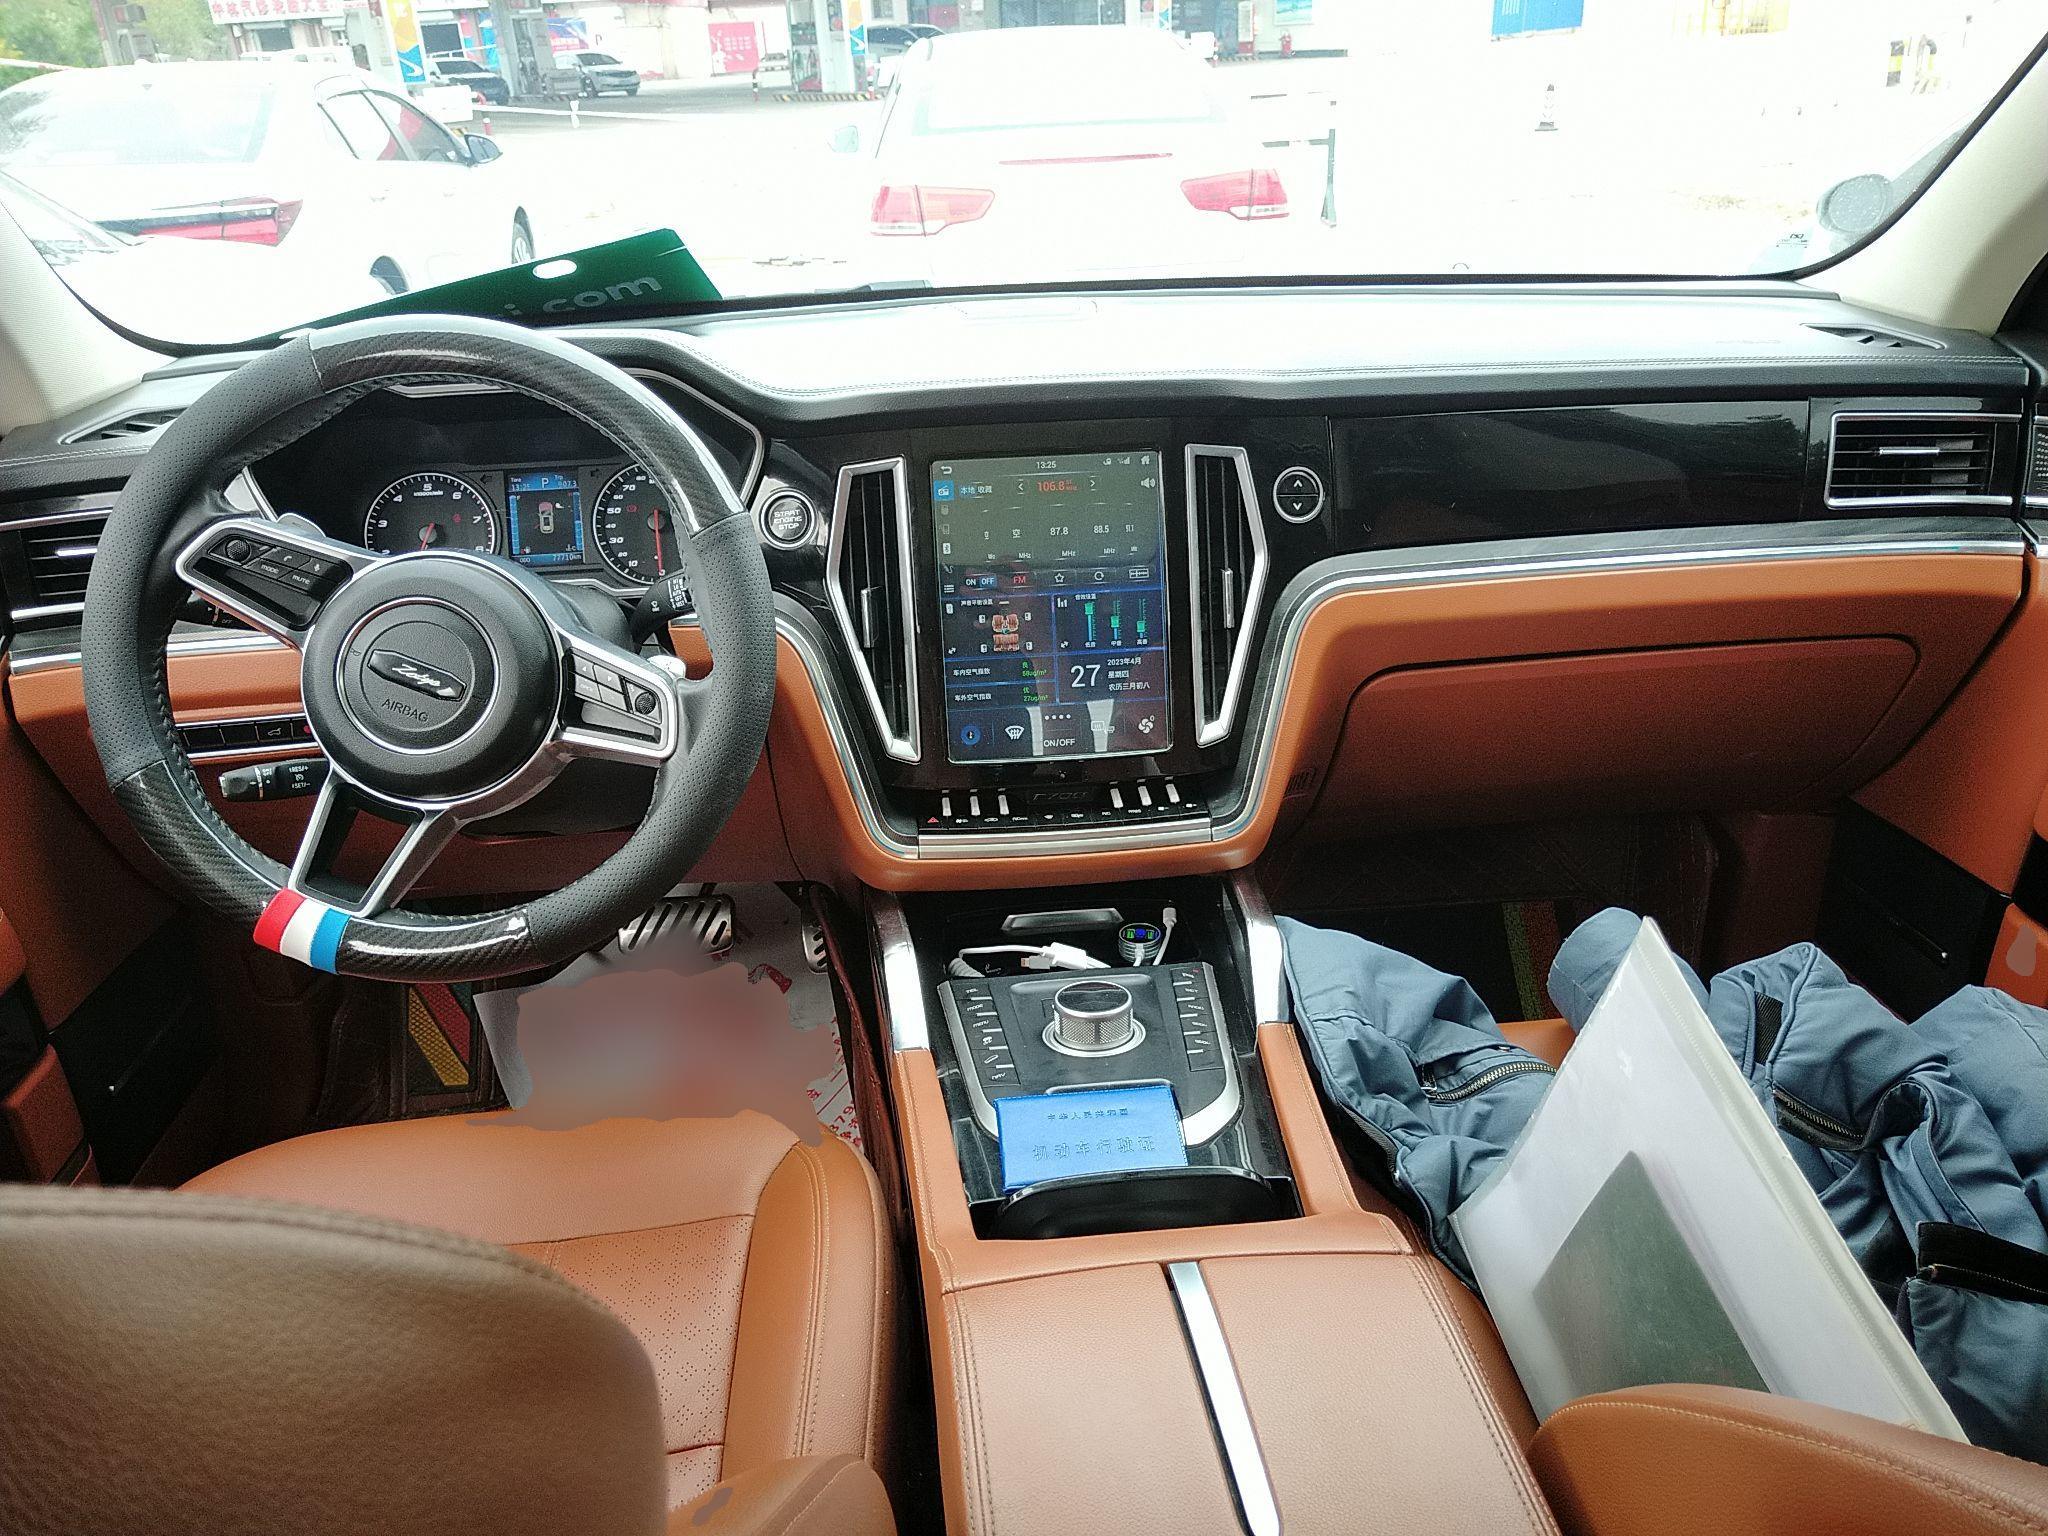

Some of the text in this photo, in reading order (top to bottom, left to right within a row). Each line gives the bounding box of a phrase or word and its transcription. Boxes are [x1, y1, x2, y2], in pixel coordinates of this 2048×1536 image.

[1036, 461, 1057, 469] 13:25
[423, 483, 432, 491] 5
[541, 477, 549, 488] P
[1037, 480, 1065, 491] 106.8
[774, 509, 801, 518] START
[378, 520, 388, 528] 3
[472, 516, 482, 524] 7
[778, 522, 800, 530] STOP
[1050, 526, 1069, 536] 87.8
[609, 536, 624, 544] 30
[1061, 550, 1077, 558] MHz
[965, 577, 995, 586] ON OFF
[1013, 576, 1027, 584] FM
[1107, 656, 1142, 666] 2023年4月
[1070, 664, 1101, 688] 27
[1107, 670, 1130, 679] 星期四
[381, 698, 429, 723] AIRBAG
[1043, 737, 1076, 748] ON/OFF
[1032, 1136, 1155, 1162] 机动车行驶证
